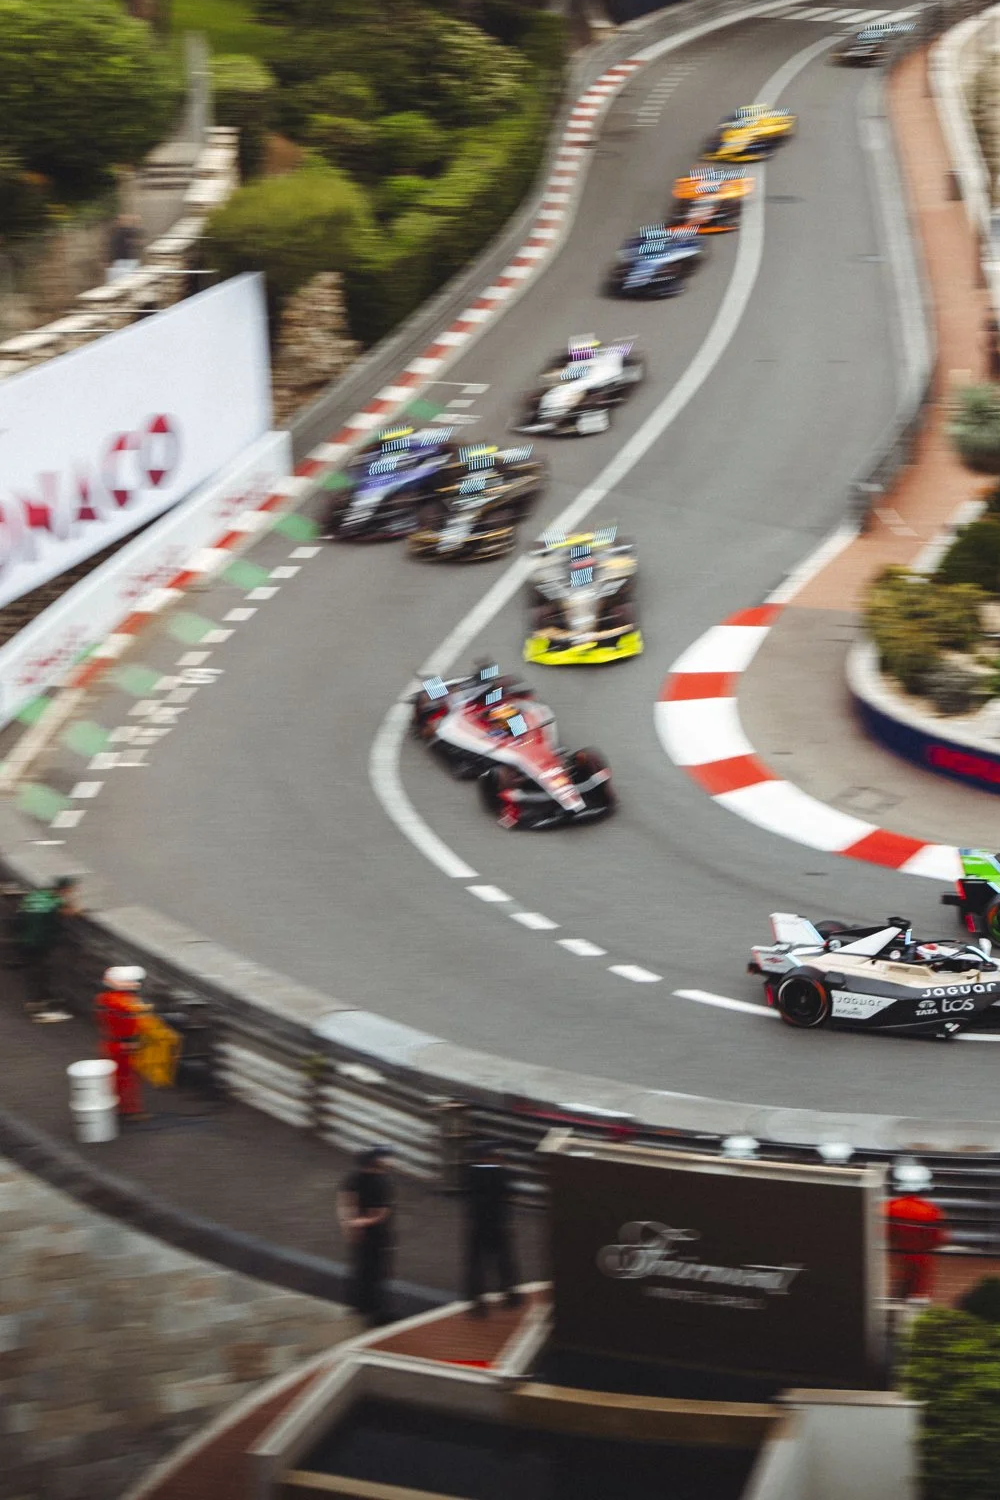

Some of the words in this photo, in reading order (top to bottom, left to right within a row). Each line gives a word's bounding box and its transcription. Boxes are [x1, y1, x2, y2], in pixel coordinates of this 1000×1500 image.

[0, 412, 184, 572] NACO
[915, 1008, 938, 1016] TATA
[941, 998, 975, 1013] tcs
